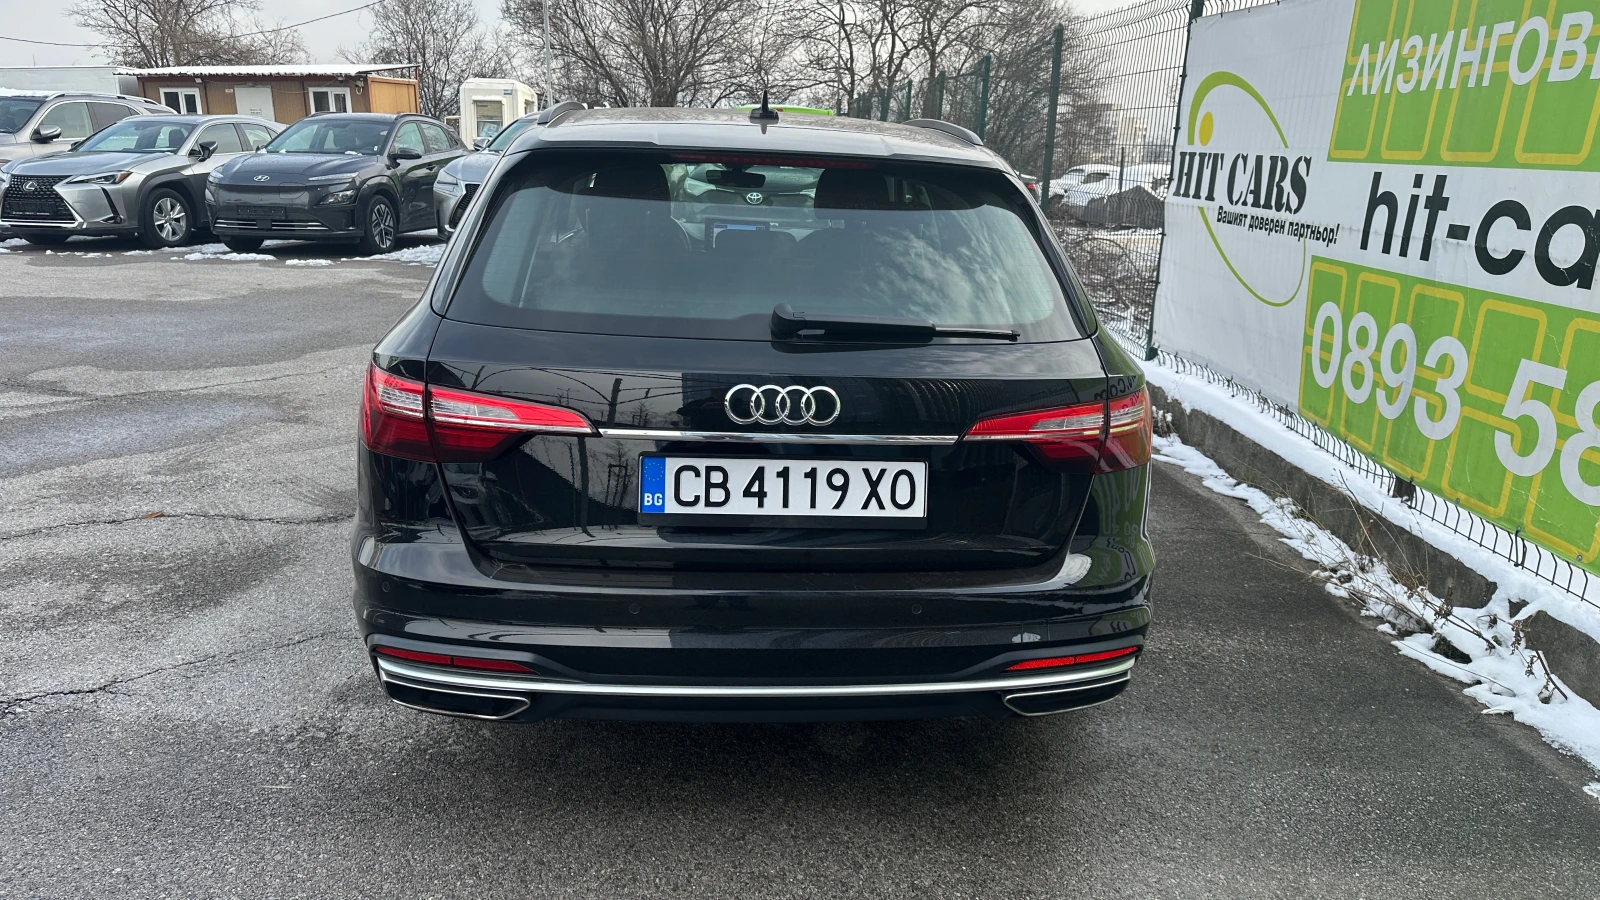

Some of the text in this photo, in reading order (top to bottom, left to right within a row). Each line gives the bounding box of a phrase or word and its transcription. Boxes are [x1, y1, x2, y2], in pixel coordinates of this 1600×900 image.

[1347, 11, 1600, 97] ЛИЗИНГОВ
[1172, 151, 1312, 215] HIT CARS
[1217, 205, 1340, 247] Вашият доверен партньор!
[1311, 301, 1468, 440] 0893
[644, 493, 663, 506] BG
[673, 464, 916, 510] CB 4119 XO
